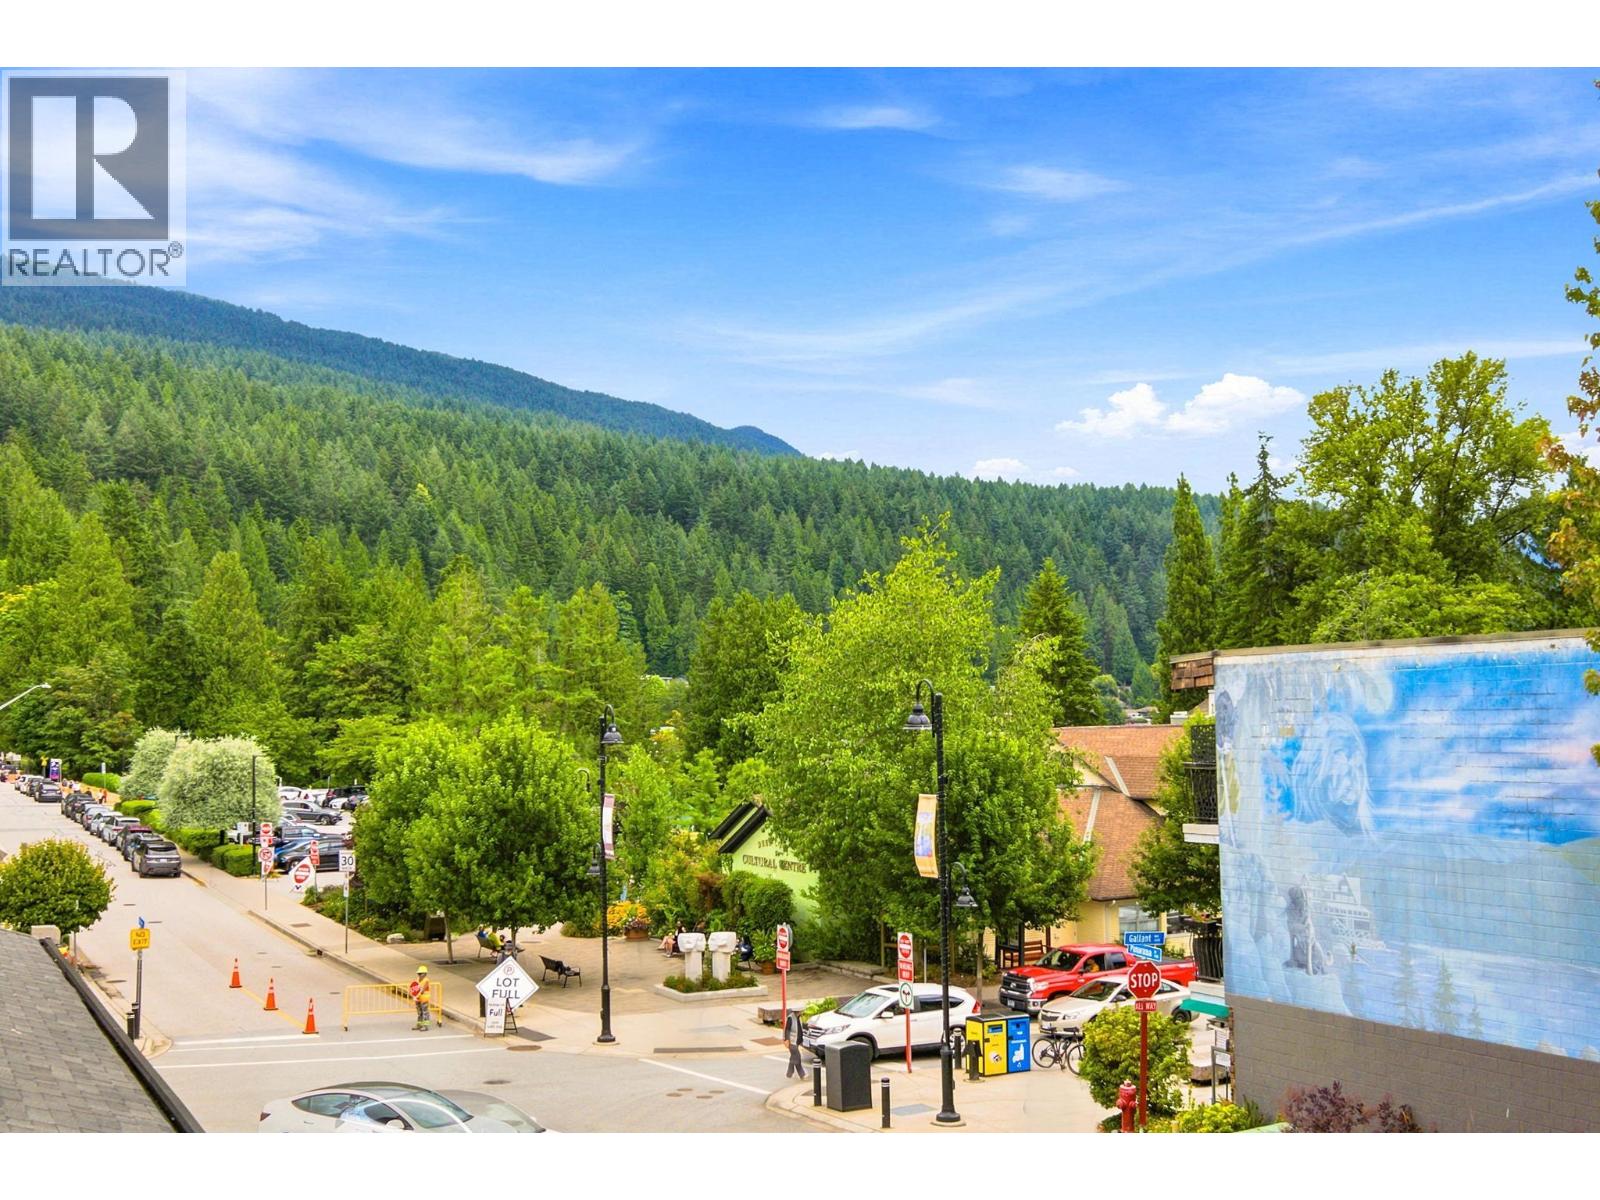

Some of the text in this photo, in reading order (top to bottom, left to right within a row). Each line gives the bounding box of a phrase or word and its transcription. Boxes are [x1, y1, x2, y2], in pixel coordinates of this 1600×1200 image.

[341, 855, 354, 866] 30
[742, 854, 778, 869] CULTURAL
[1128, 934, 1152, 943] Gallant
[496, 977, 520, 987] LOT
[1130, 972, 1158, 989] STOP
[492, 989, 521, 999] FULL
[489, 1008, 503, 1017] Full
